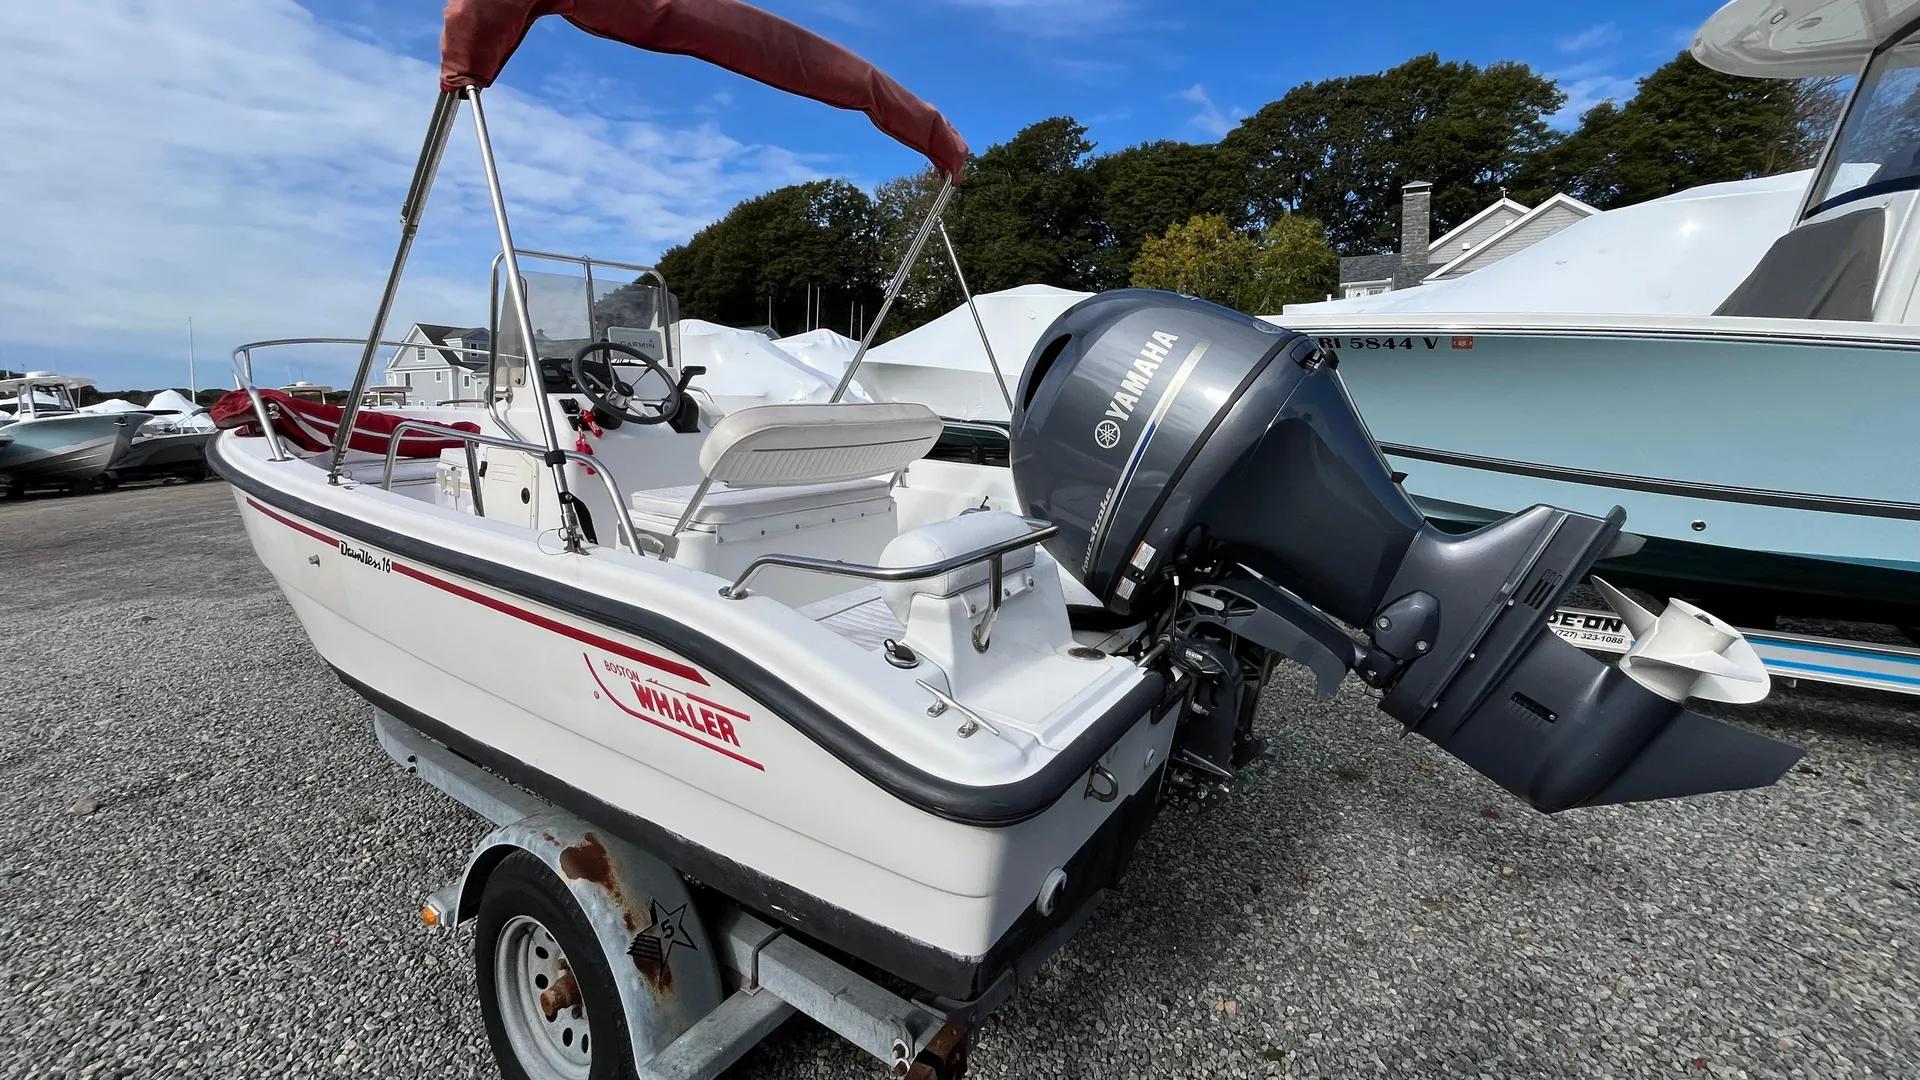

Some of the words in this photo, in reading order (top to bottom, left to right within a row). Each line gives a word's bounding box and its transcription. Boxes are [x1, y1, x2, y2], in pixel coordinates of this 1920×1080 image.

[620, 340, 655, 349] GARMIN
[1318, 337, 1341, 349] RI
[1350, 337, 1414, 350] 5844
[1423, 336, 1439, 350] V
[1104, 330, 1179, 421] YAMAHA
[1081, 487, 1113, 574] fourstroke
[340, 540, 381, 571] Dauntless
[382, 556, 391, 574] 16
[1555, 629, 1578, 640] (727)
[1580, 632, 1624, 645] 323-1088
[603, 660, 640, 682] BOSTON
[630, 681, 741, 748] WHALER
[660, 918, 675, 939] 5
